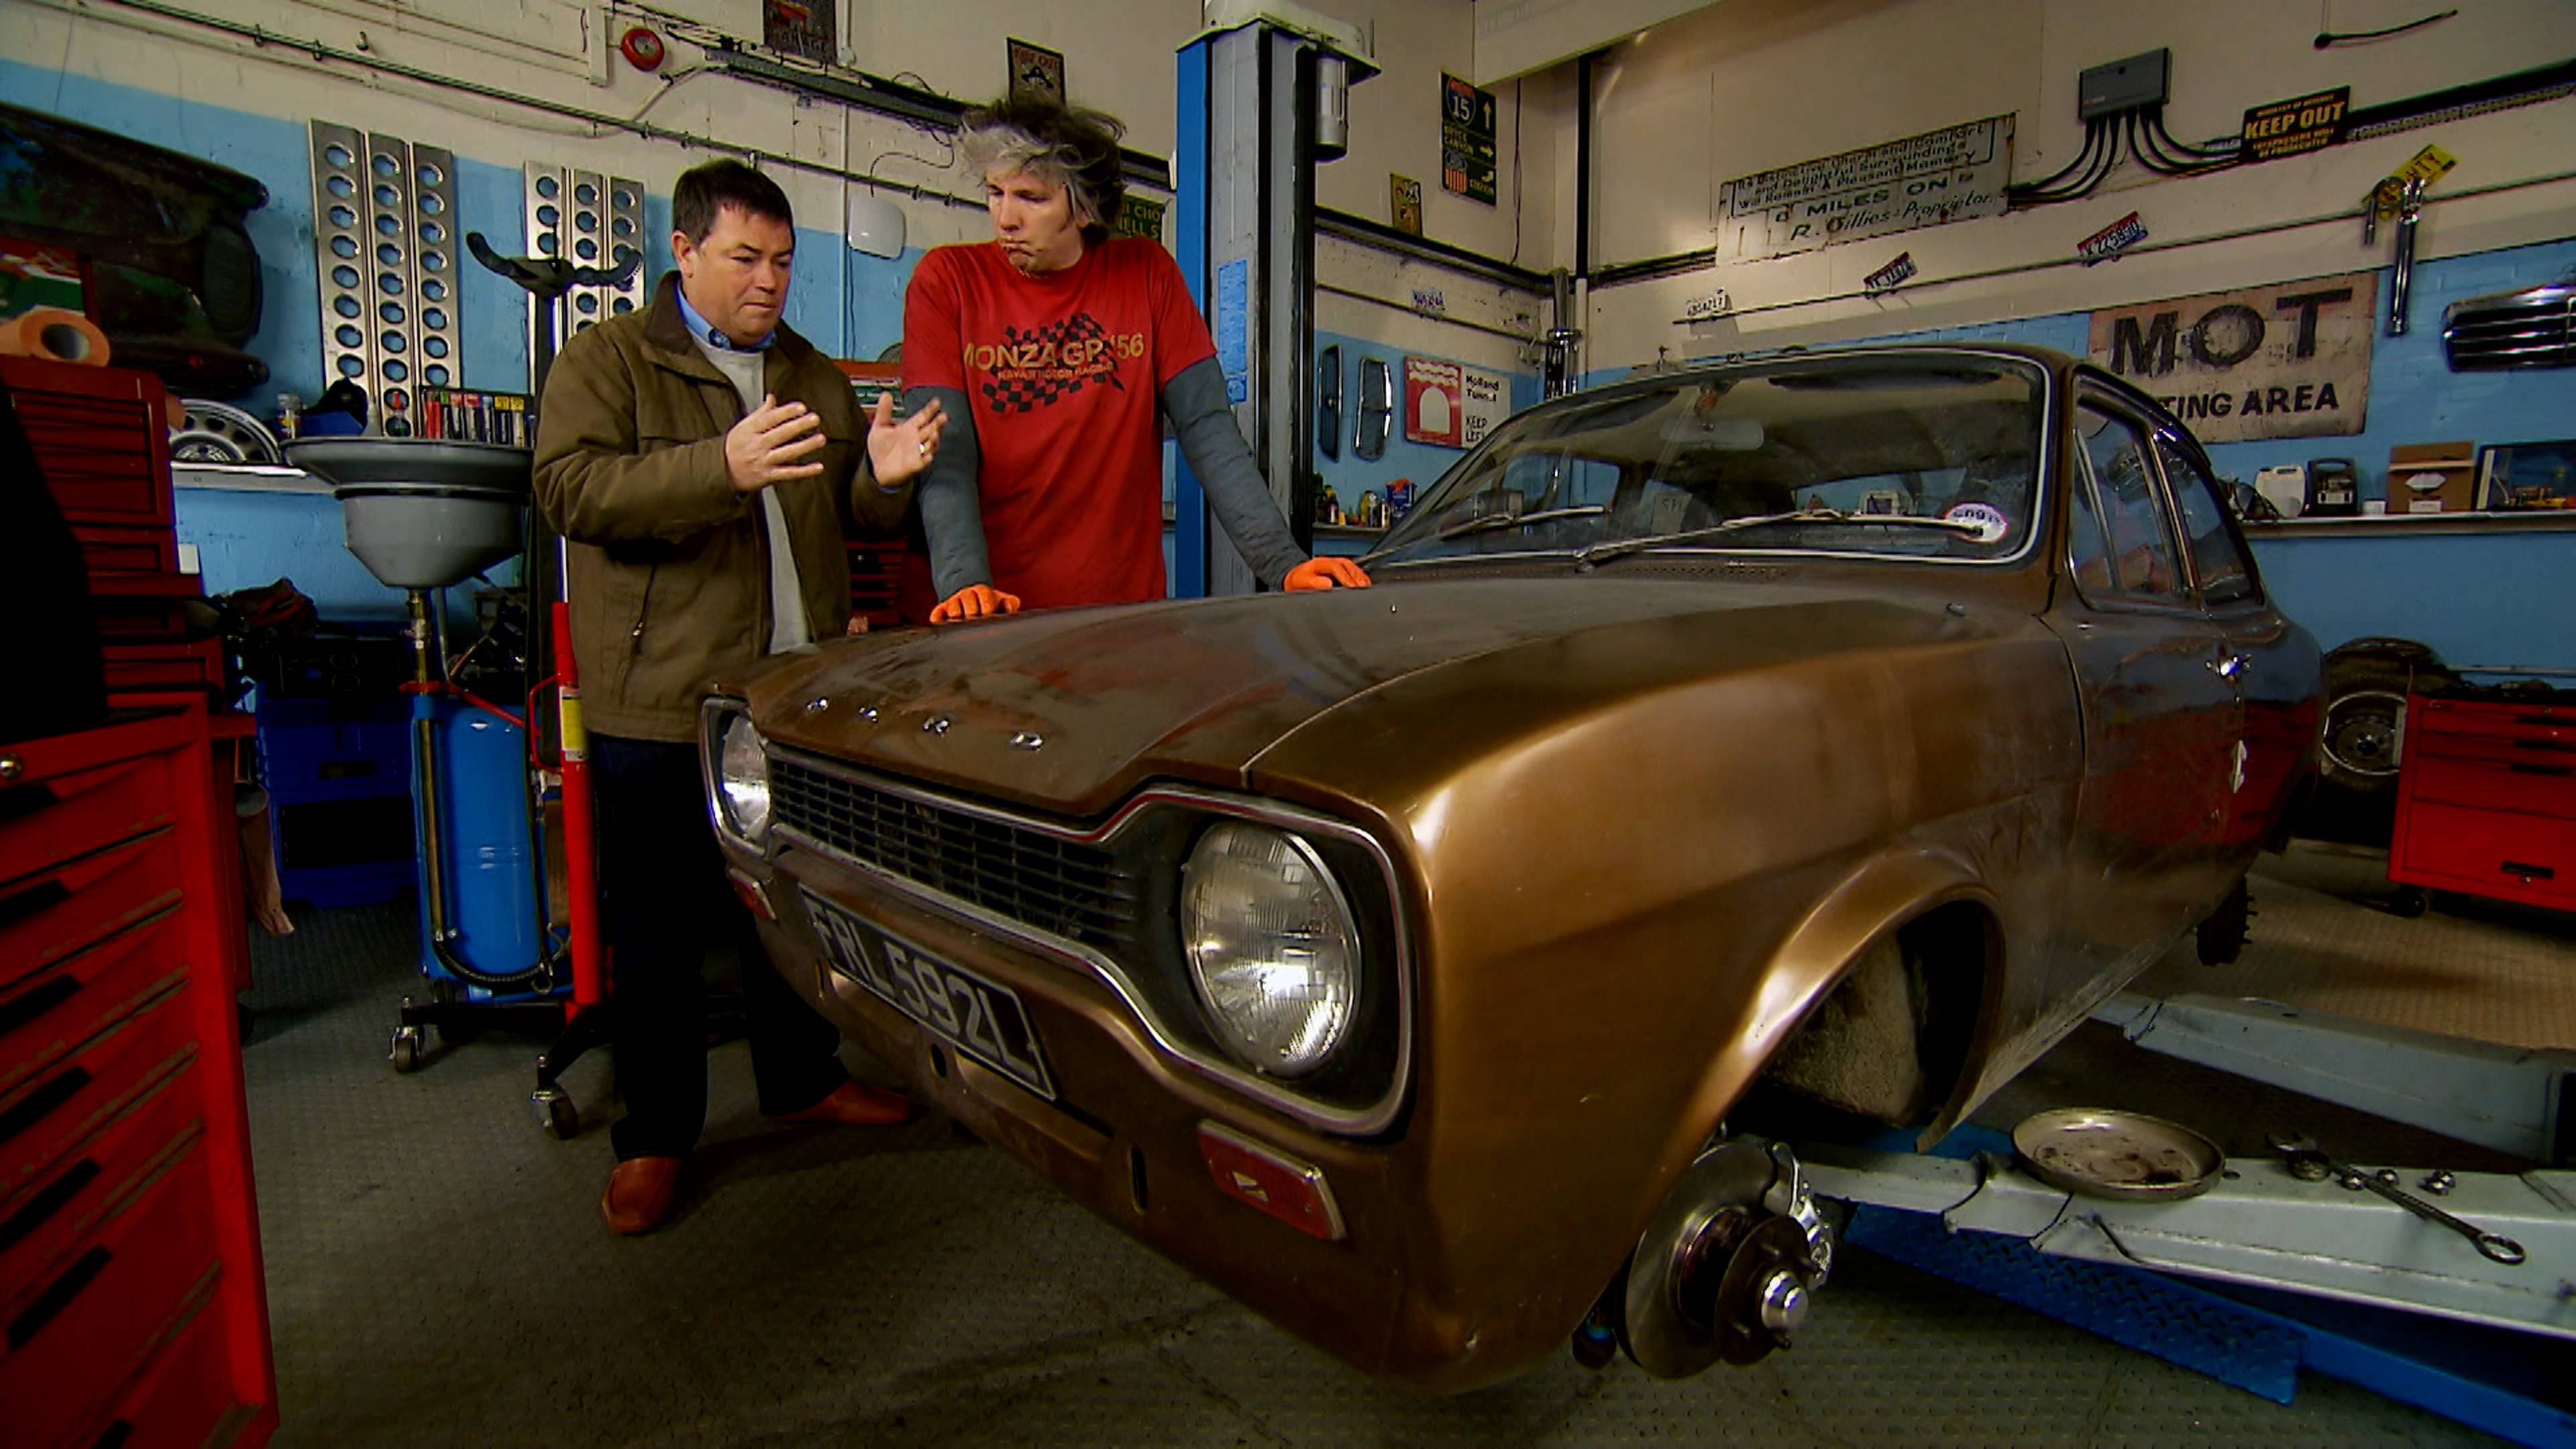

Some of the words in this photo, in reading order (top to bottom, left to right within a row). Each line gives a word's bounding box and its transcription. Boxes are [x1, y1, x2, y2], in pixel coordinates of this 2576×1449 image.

[1453, 96, 1470, 121] 15
[2245, 113, 2296, 139] KEEP
[2300, 101, 2346, 129] OUT
[1807, 190, 1890, 217] MILES
[1907, 178, 1947, 196] ON
[2110, 286, 2353, 378] MOT
[1062, 339, 1104, 366] GP
[2159, 391, 2233, 419] TING
[2240, 382, 2339, 416] AREA
[1466, 416, 1488, 429] KEEP
